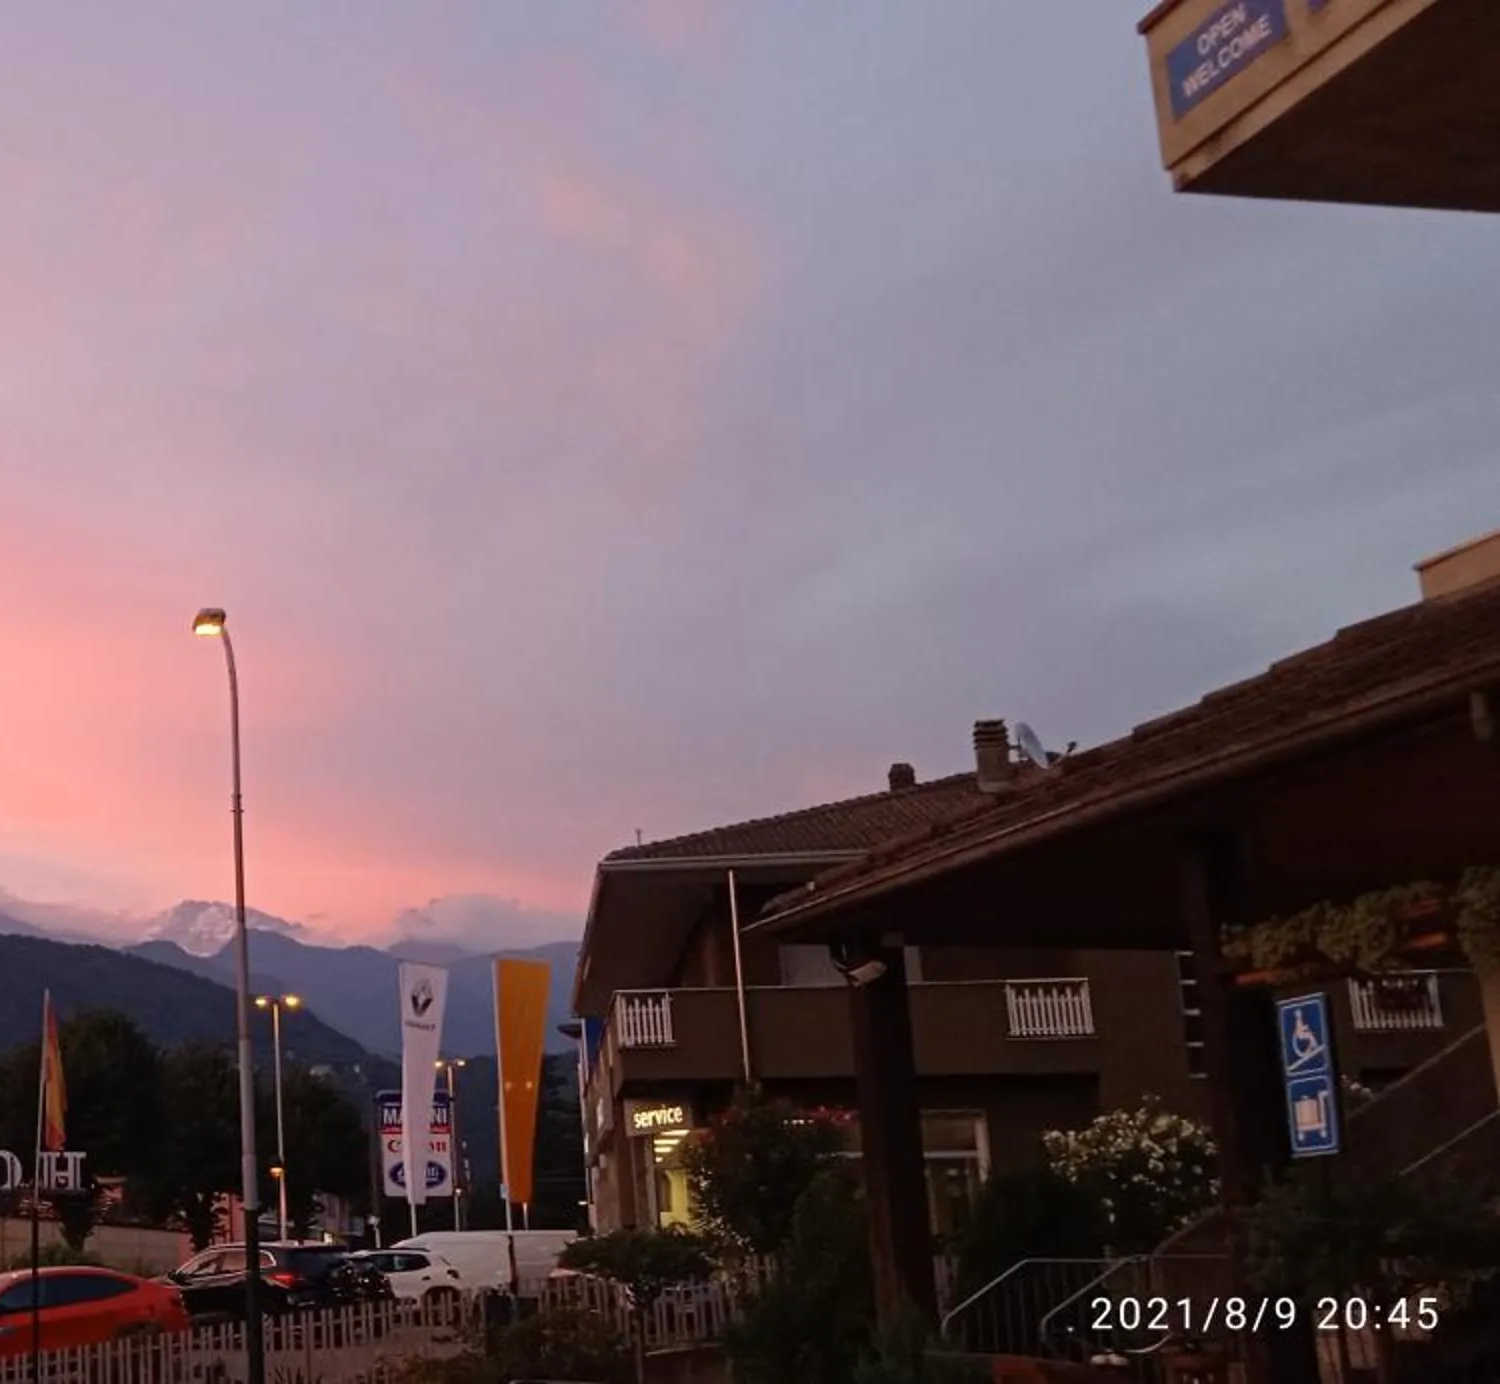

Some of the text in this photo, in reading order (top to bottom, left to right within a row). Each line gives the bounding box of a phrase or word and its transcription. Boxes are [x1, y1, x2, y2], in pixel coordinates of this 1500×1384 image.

[1197, 3, 1246, 55] OPEN
[1183, 14, 1272, 97] WELCOME
[633, 1104, 683, 1129] service
